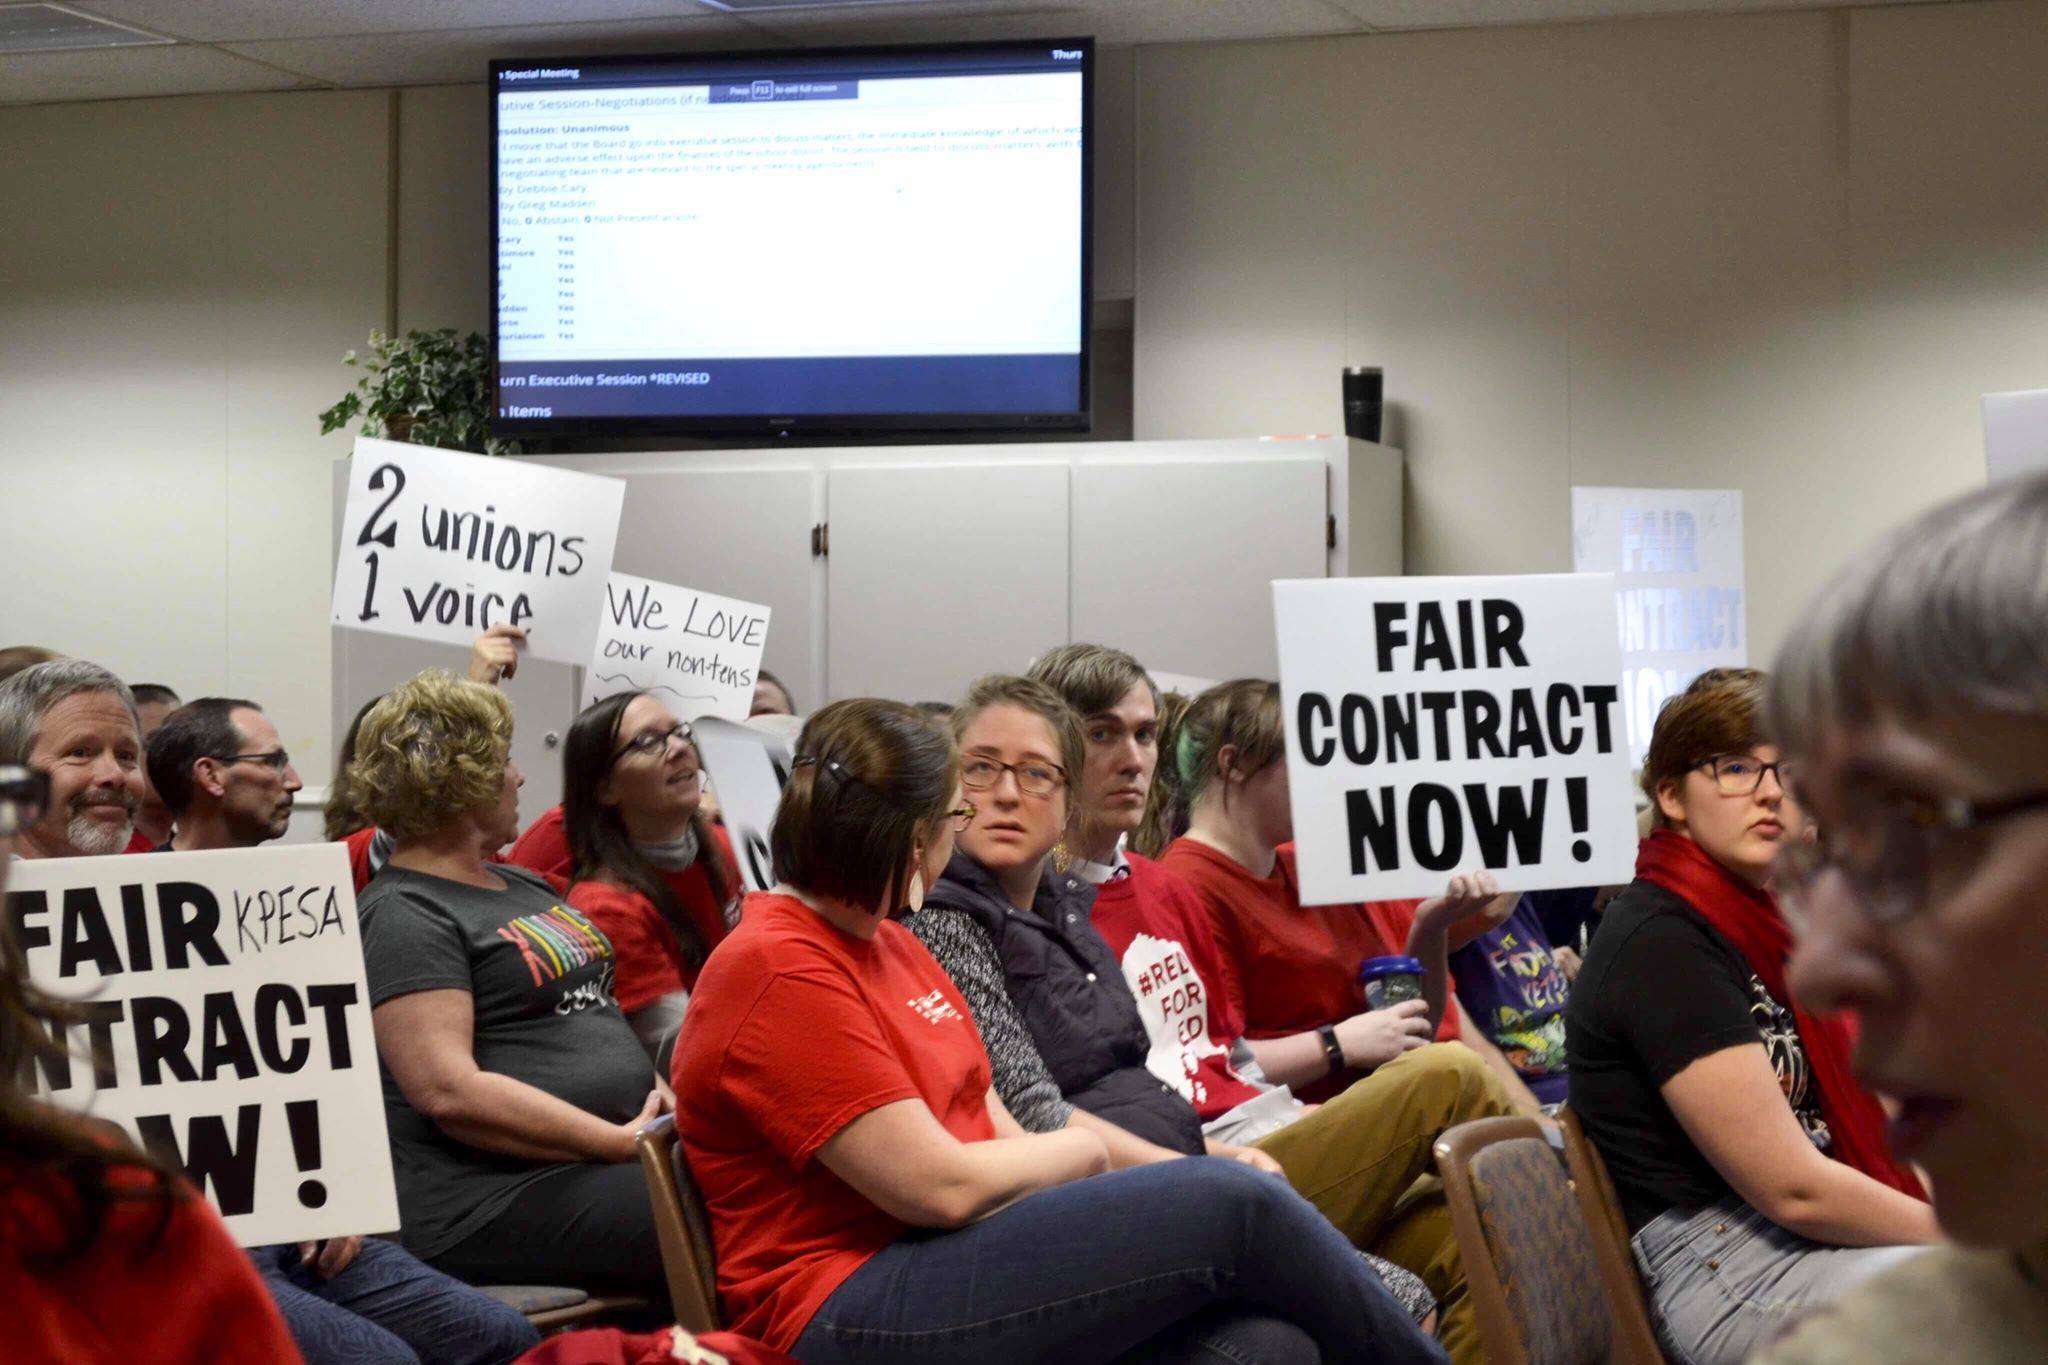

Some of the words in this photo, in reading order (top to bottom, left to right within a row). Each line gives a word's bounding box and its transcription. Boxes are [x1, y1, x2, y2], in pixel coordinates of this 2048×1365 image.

[505, 69, 540, 81] Special
[540, 68, 580, 80] Meeting
[562, 124, 630, 134] Unanimous
[558, 234, 575, 244] Yes
[558, 248, 575, 258] Yes
[558, 262, 575, 272] Yes
[558, 275, 575, 285] Yes
[558, 289, 575, 299] Yes
[558, 303, 575, 313] Yes
[558, 317, 575, 327] Yes
[558, 331, 575, 341] Yes
[528, 374, 594, 388] Executive
[596, 373, 648, 387] Session
[509, 405, 552, 419] Items
[356, 463, 406, 548] 2
[421, 504, 588, 577] unions
[1621, 509, 1698, 573] FAIR
[358, 550, 379, 622] 1
[402, 581, 533, 636] voice
[608, 582, 669, 630] We
[683, 597, 766, 647] LOVE
[1617, 585, 1741, 653] NTRACT
[1373, 599, 1530, 673] FAIR
[604, 638, 654, 662] our
[667, 650, 752, 689] non-tens
[1297, 682, 1618, 767] CONTRACT
[4, 881, 230, 978] FAIR
[233, 885, 346, 953] KPESA
[1161, 982, 1203, 1023] FOR
[28, 983, 358, 1095] NTRACT
[1178, 1014, 1204, 1047] ED
